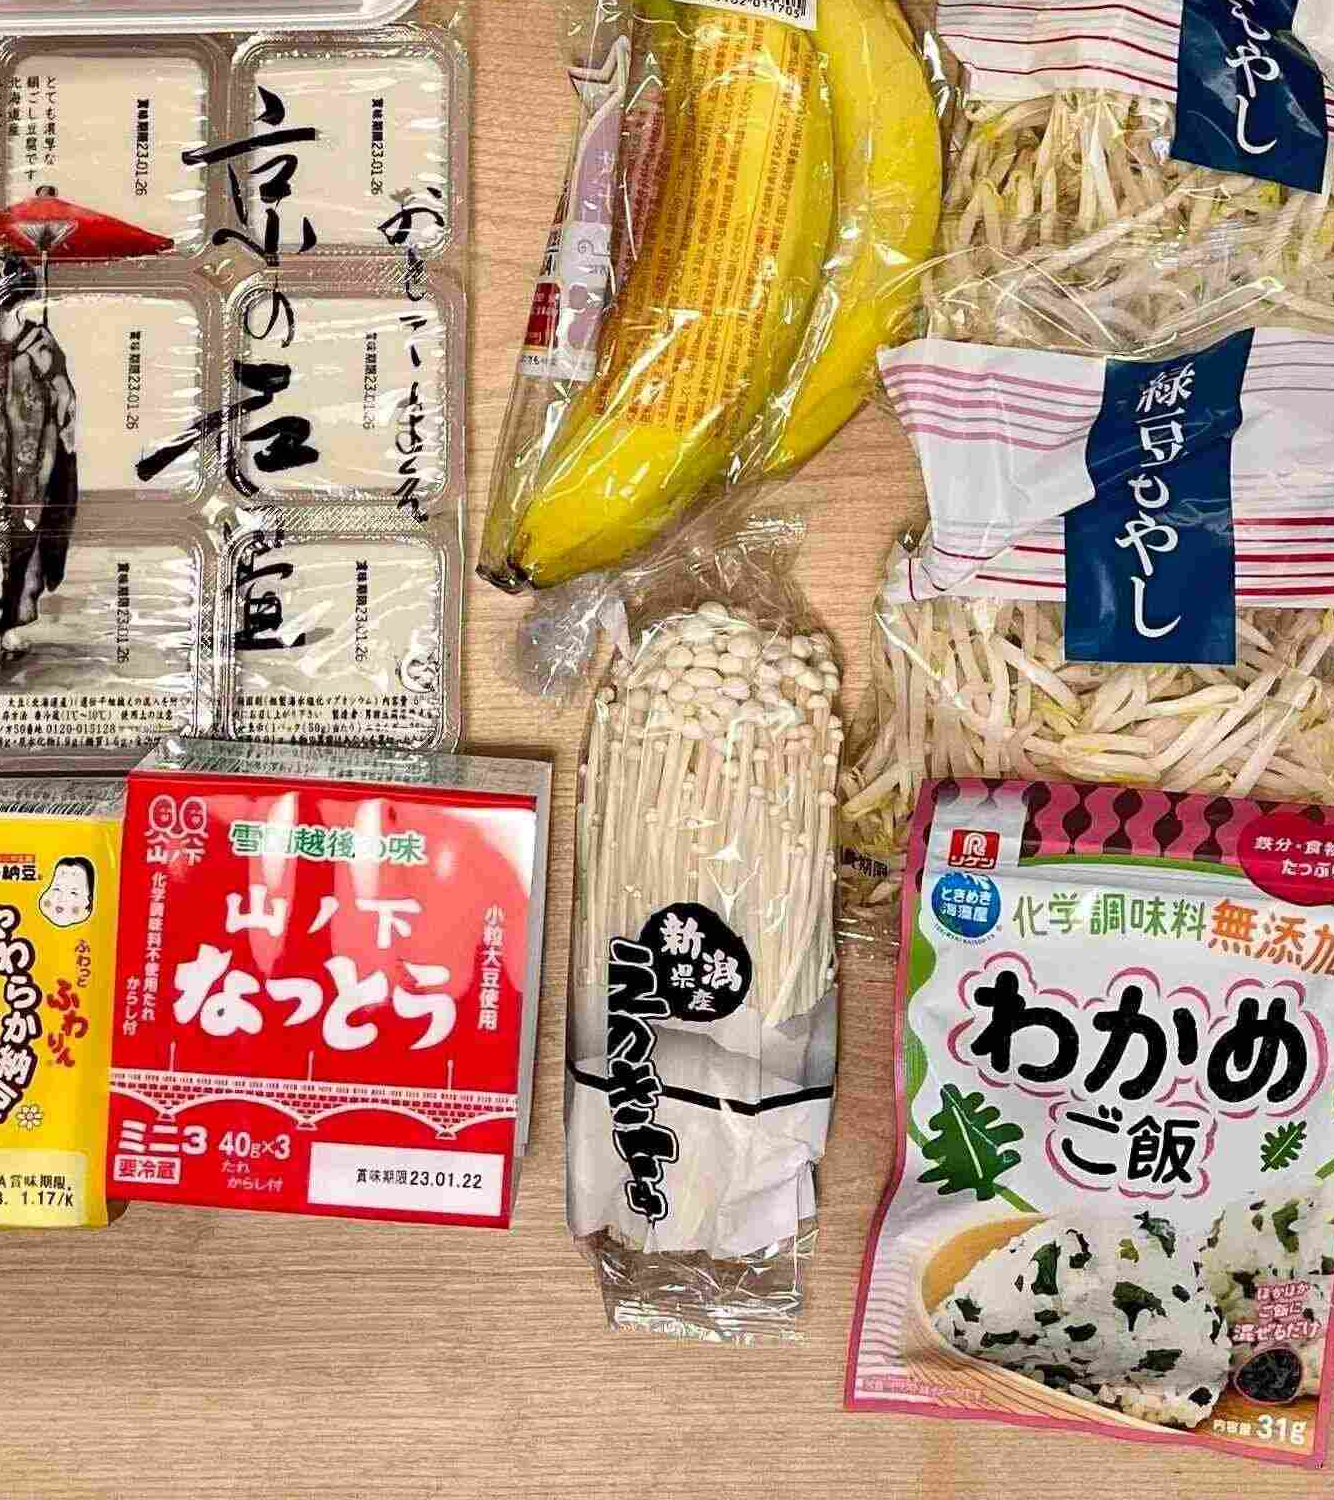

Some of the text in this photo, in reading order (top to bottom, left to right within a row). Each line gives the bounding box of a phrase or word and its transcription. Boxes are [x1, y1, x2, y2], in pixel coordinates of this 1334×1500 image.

[1114, 362, 1197, 640] 緑豆もやし
[146, 842, 204, 866] 山ノ下
[963, 832, 988, 856] R
[950, 855, 995, 869] リケン
[941, 887, 991, 906] ときめき
[226, 884, 422, 950] 山ノ下
[75, 940, 92, 988] ふわっと
[477, 905, 505, 1032] 小粒大豆使用
[122, 976, 141, 1036] からし付
[172, 944, 457, 1051] なっとう
[47, 979, 88, 1068] ふわりん
[970, 970, 1308, 1103] わかめ
[118, 1119, 209, 1156] ミニ3
[218, 1132, 290, 1159] 40g×3
[1060, 1106, 1200, 1184] ご飯
[117, 1159, 176, 1180] 要冷蔵
[221, 1161, 251, 1174] たれ
[356, 1167, 482, 1190] 賞味期限23.01.22
[227, 1176, 283, 1192] からし付
[1257, 1282, 1310, 1300] ほかほか
[1259, 1301, 1303, 1318] ご飯に
[1232, 1321, 1322, 1342] 混ぜるだけ
[1257, 1414, 1307, 1445] 31g
